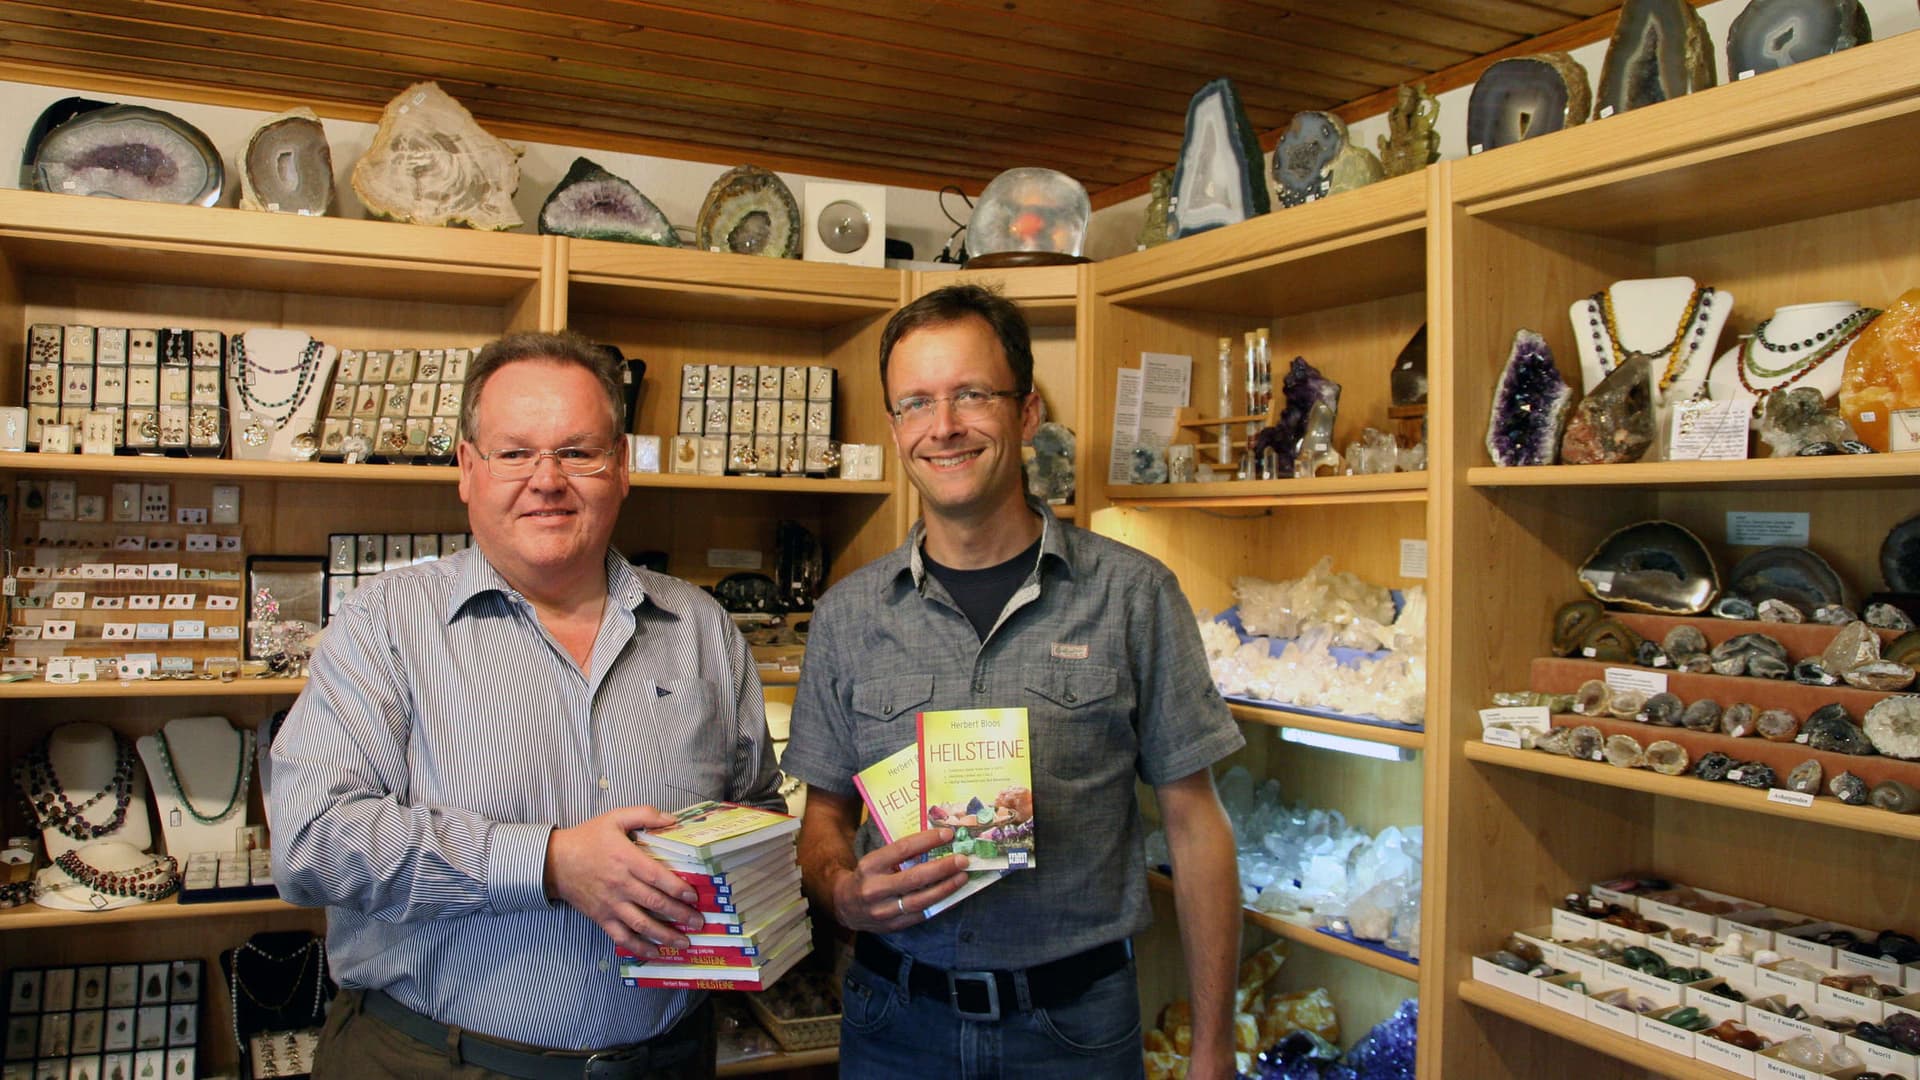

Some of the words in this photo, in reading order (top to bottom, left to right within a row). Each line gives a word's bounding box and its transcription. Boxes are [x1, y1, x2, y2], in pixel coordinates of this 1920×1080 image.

[951, 720, 979, 729] Herbert
[981, 719, 1000, 728] Bloos
[929, 739, 1025, 763] HEILSTEINE
[888, 758, 913, 776] Herbert
[697, 979, 735, 990] HEILSTEINE
[1832, 992, 1865, 1006] Mondstein
[1777, 1019, 1812, 1032] Feuerstein
[1701, 1040, 1730, 1054] Aventurin
[1868, 1047, 1891, 1059] Fluorit
[1767, 1063, 1806, 1080] Bergkristall
